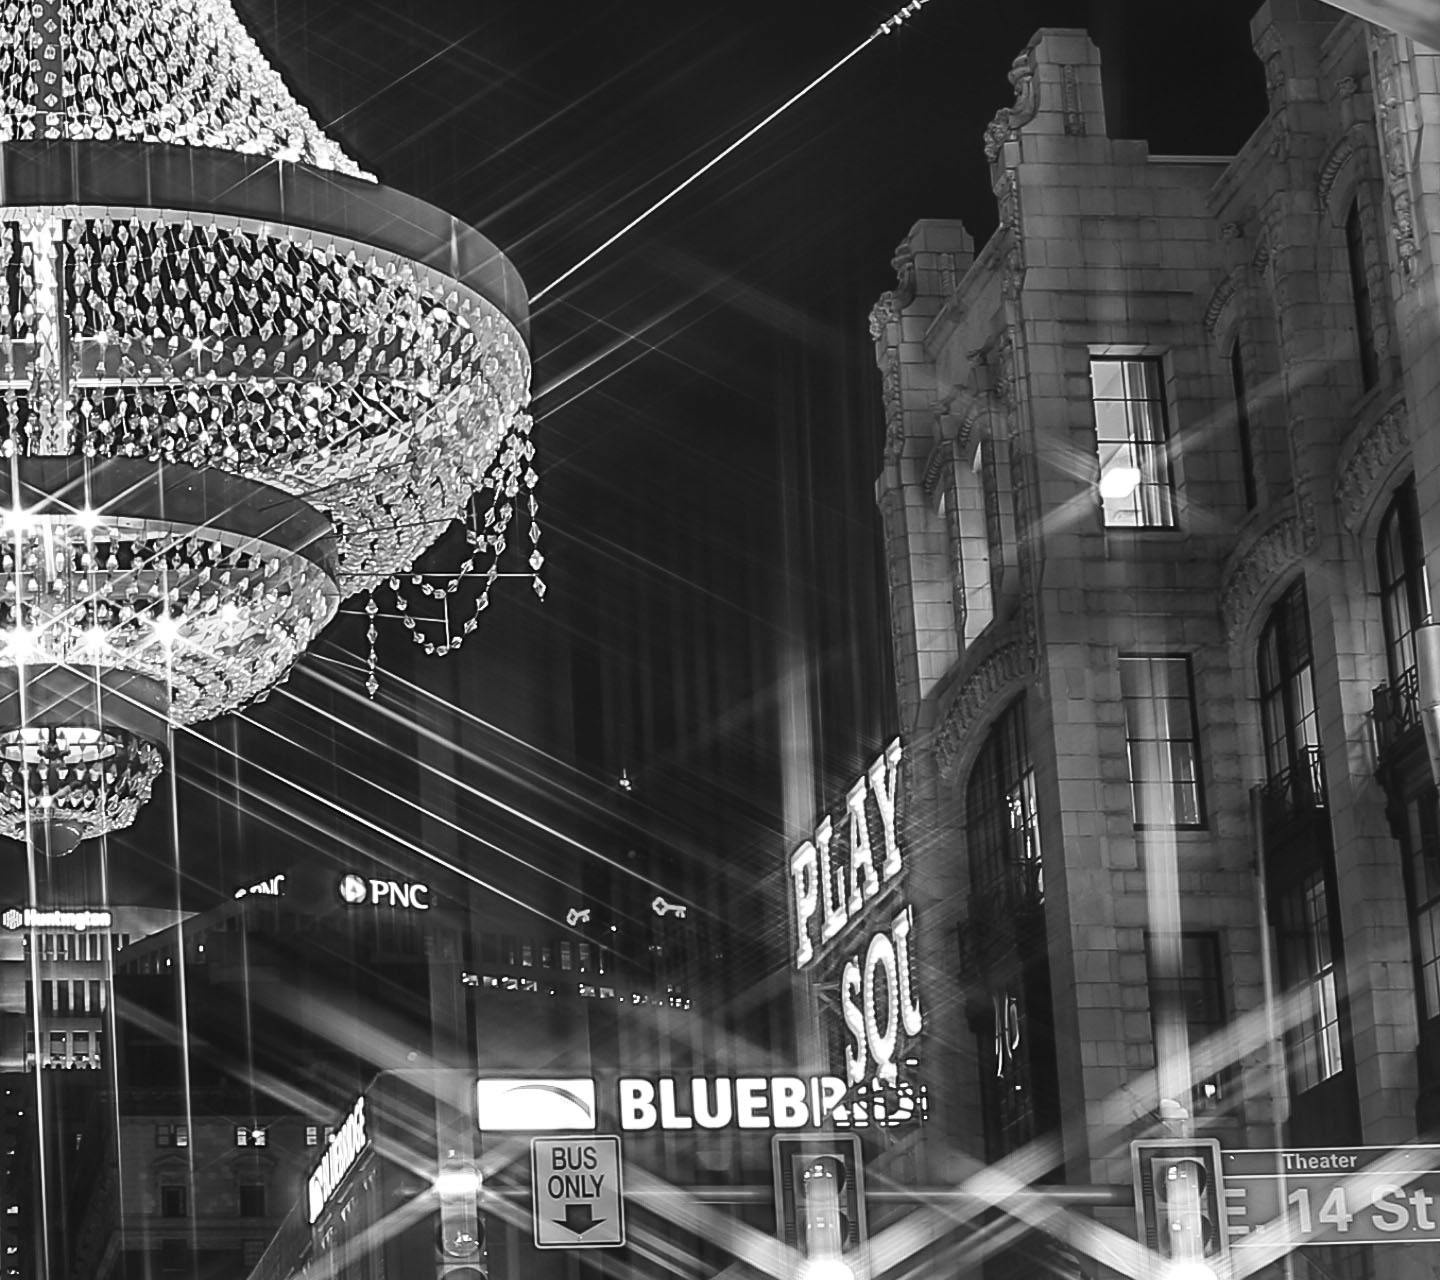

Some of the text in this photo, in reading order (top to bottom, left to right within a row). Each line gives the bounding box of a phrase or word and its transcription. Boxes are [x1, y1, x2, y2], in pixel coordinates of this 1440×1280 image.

[791, 736, 903, 969] PLAY
[369, 879, 429, 910] PNC
[552, 1146, 597, 1171] BUS
[1282, 1153, 1358, 1170] Theater
[547, 1174, 605, 1199] ONLY
[1288, 1187, 1353, 1233] 14
[1371, 1184, 1436, 1232] St
